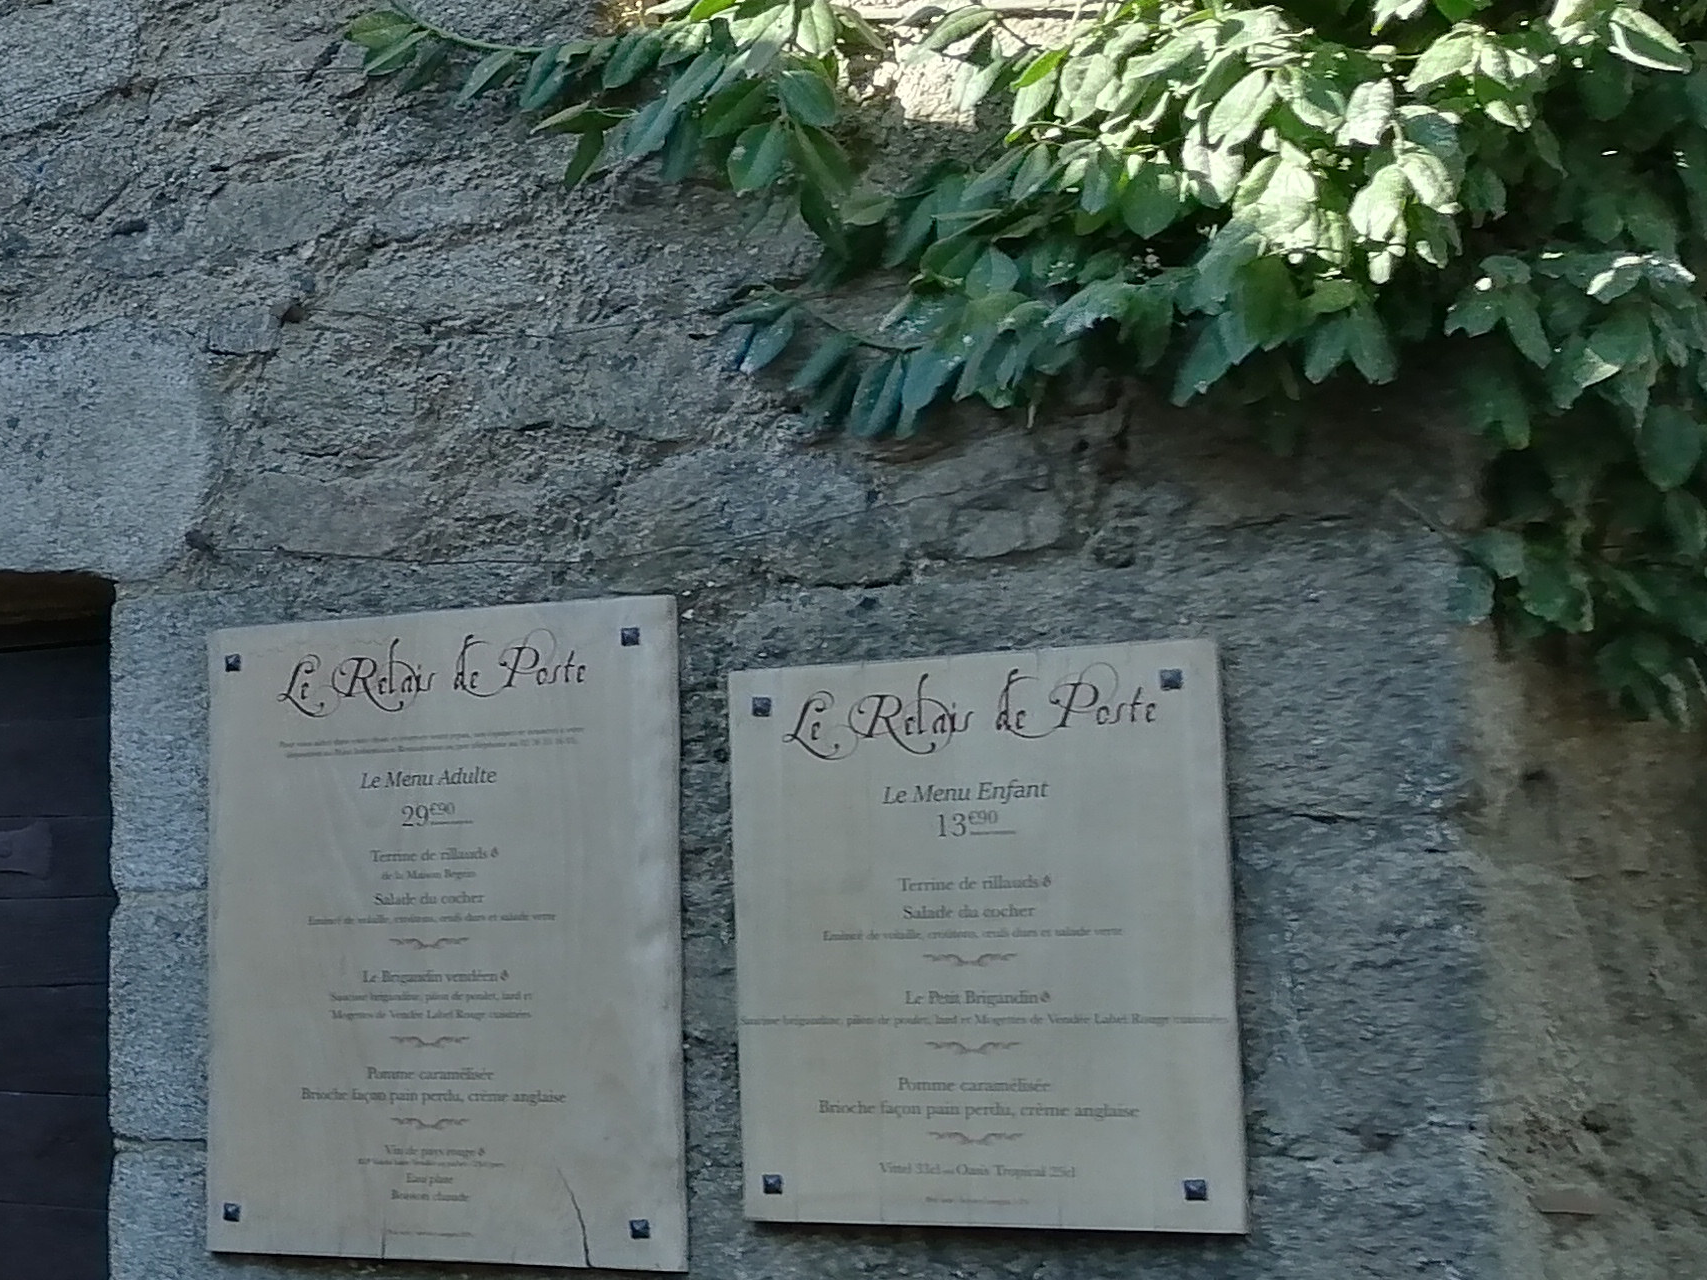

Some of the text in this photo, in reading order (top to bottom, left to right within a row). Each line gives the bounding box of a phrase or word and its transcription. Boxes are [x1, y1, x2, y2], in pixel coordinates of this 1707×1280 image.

[277, 628, 588, 718] Le Relais de Poste
[782, 662, 1158, 761] Le Relais de Poste
[360, 766, 498, 789] Le Menu Adulte
[882, 778, 1050, 805] Le Menu Enfant
[371, 848, 418, 863] Terrine
[421, 847, 438, 862] de
[898, 874, 1040, 893] Terrine de rillauds
[374, 890, 486, 906] Salade du cocher
[903, 902, 1037, 920] Salade du cocher
[362, 969, 378, 983] Le
[905, 988, 1039, 1008] Le Petit Brigandin
[366, 1066, 415, 1081] Pomme
[897, 1076, 1052, 1093] Pomme caramélisée
[301, 1087, 348, 1102] Brioche
[351, 1087, 387, 1104] façon
[390, 1087, 419, 1105] pain
[511, 1089, 567, 1107] anglaise
[818, 1099, 1141, 1122] Brioche façon pain perdu, crème anglaise
